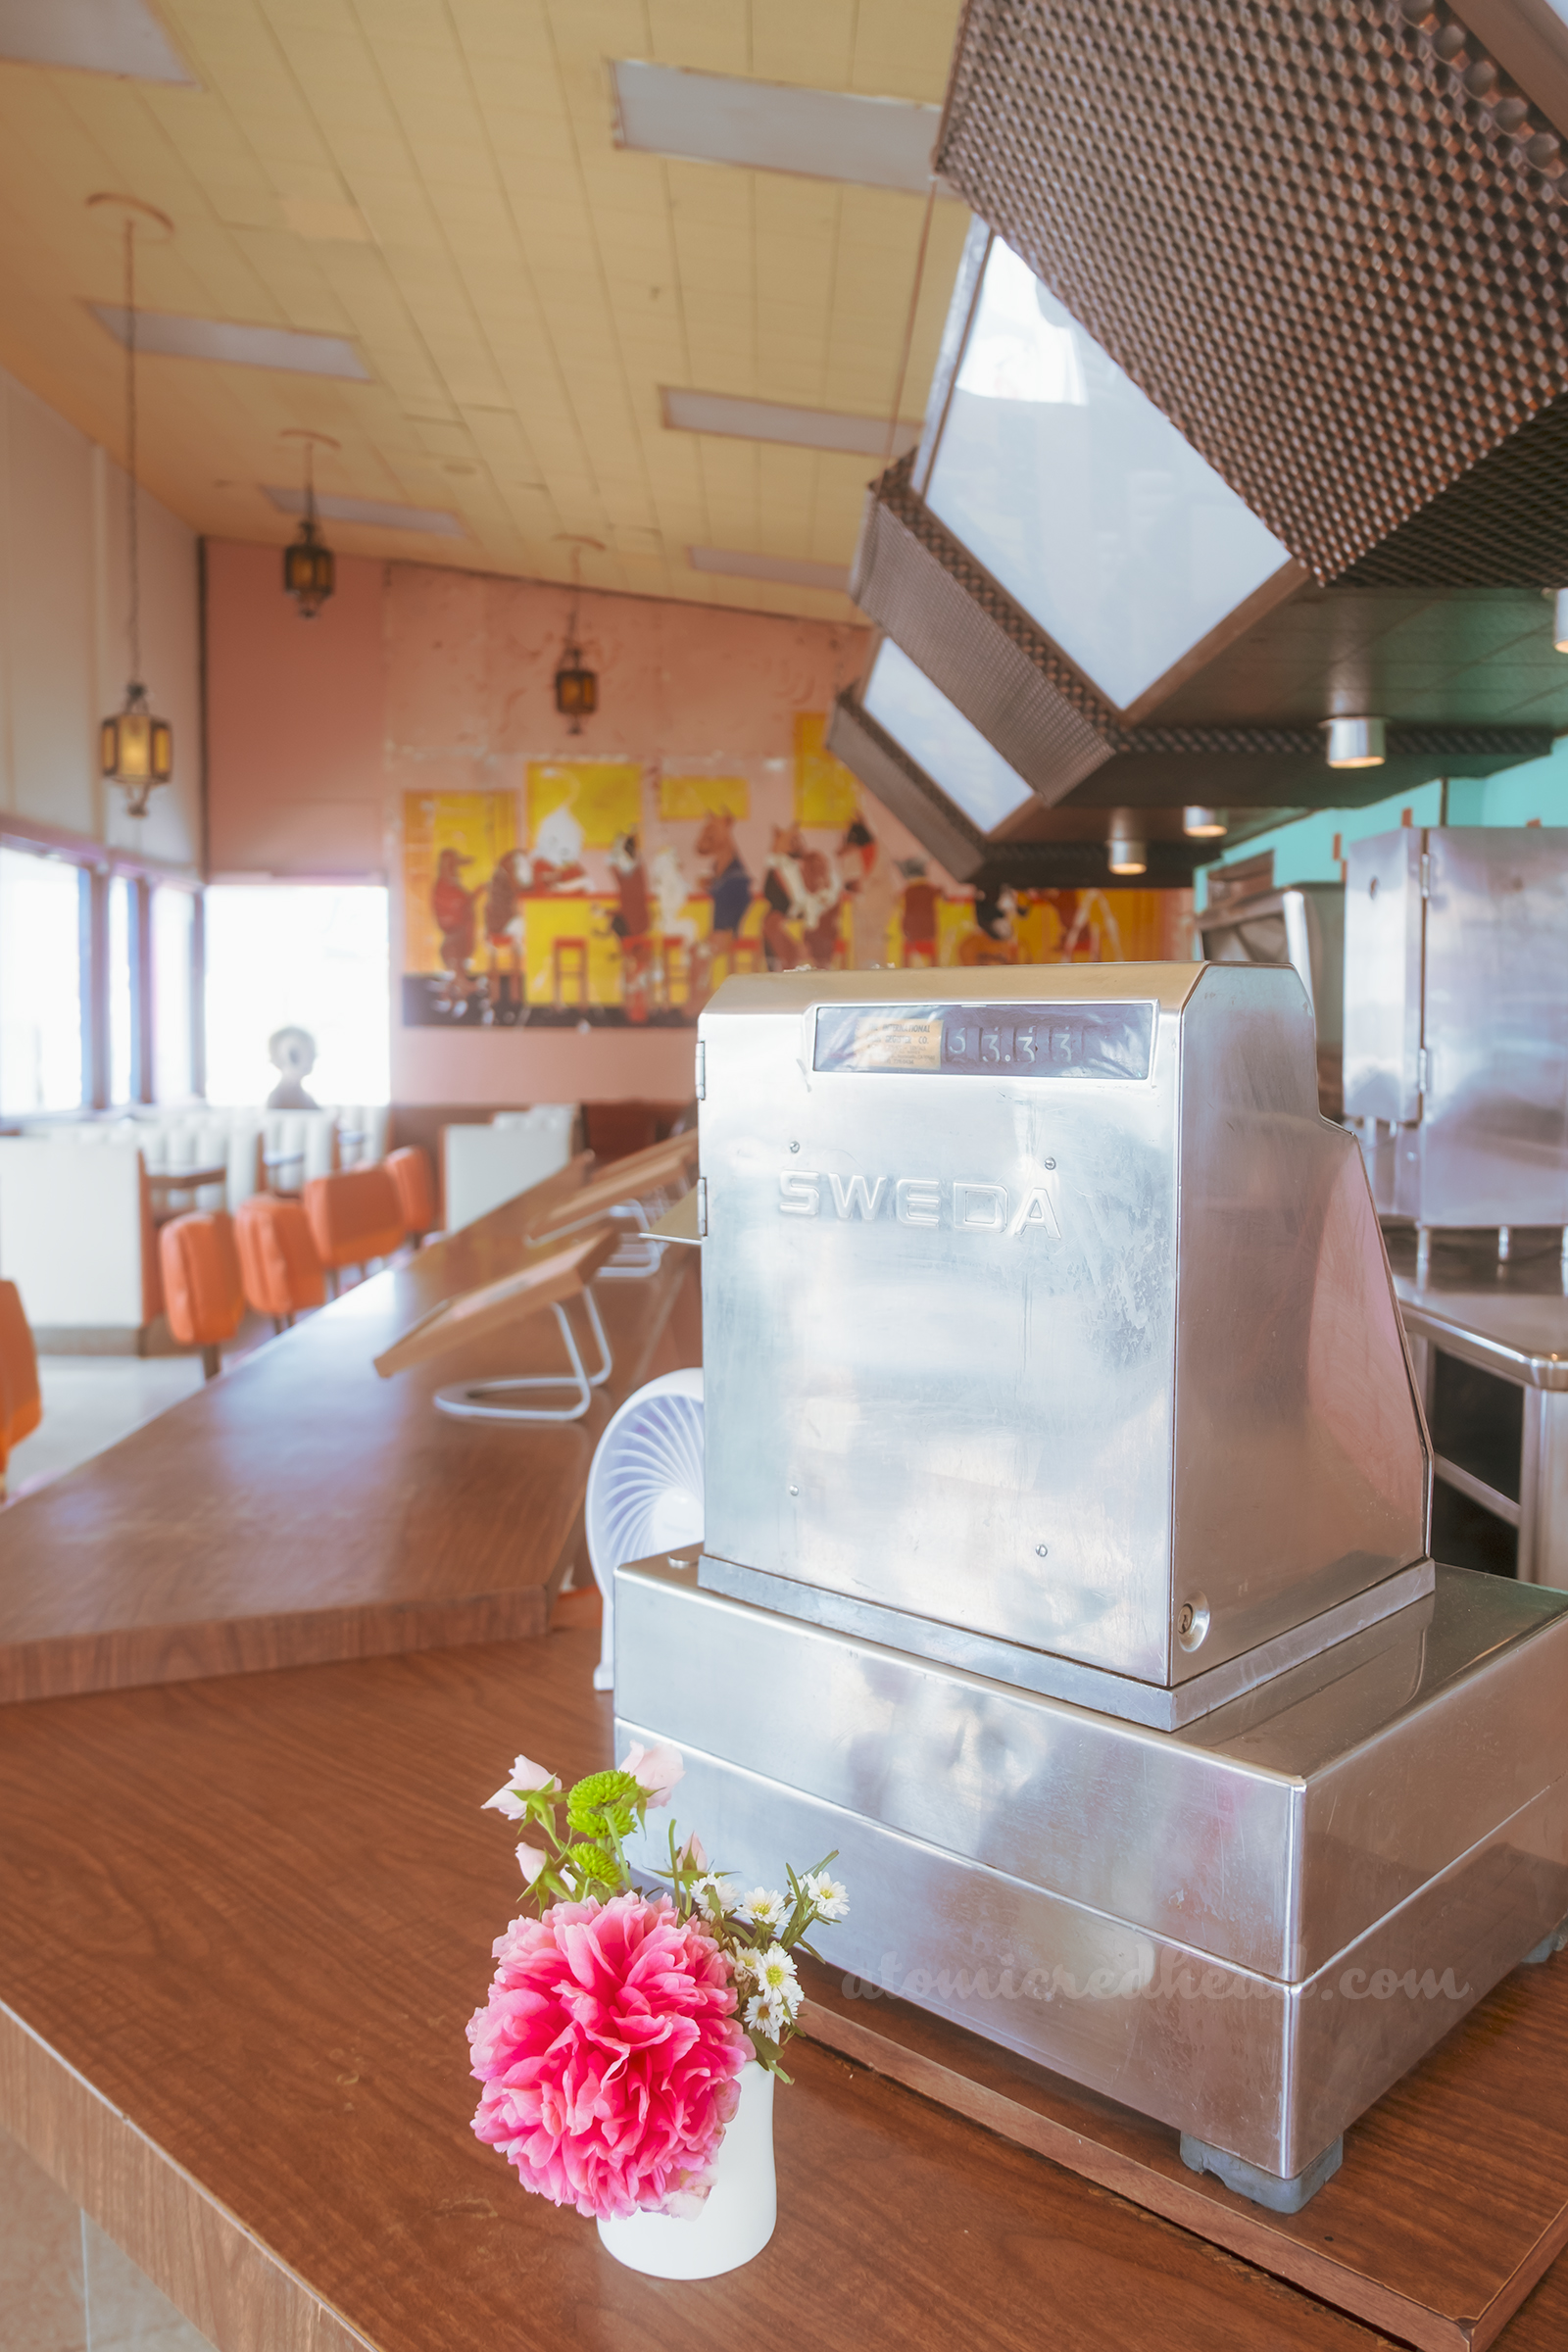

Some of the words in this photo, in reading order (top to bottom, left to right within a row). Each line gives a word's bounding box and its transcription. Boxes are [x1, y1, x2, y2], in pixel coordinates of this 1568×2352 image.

[882, 1023, 931, 1033] INTERNATIONAL
[917, 1036, 929, 1045] CO.
[780, 1169, 1061, 1240] SWEDA
